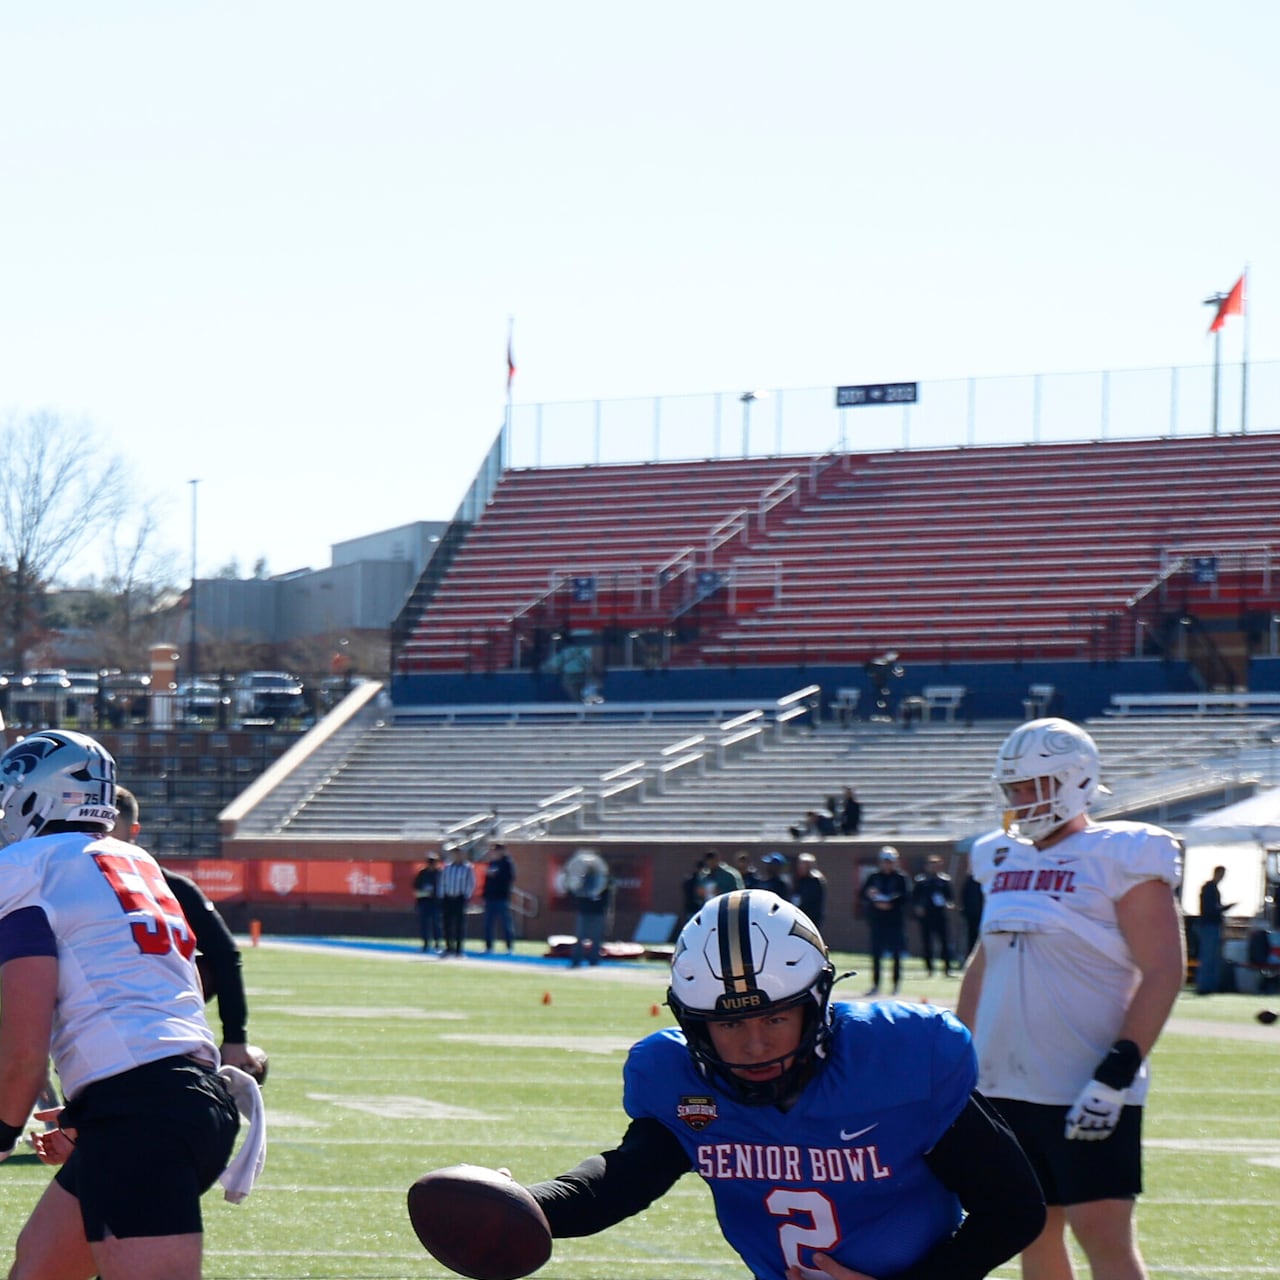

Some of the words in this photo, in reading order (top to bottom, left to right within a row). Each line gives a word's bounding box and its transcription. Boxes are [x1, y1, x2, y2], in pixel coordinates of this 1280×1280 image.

[84, 793, 99, 805] 75
[990, 869, 1035, 894] SENIOR
[1034, 869, 1077, 893] BOWL
[90, 853, 198, 961] 55
[721, 994, 761, 1010] VUFB
[696, 1143, 803, 1180] SENIOR
[807, 1145, 892, 1182] BOWL
